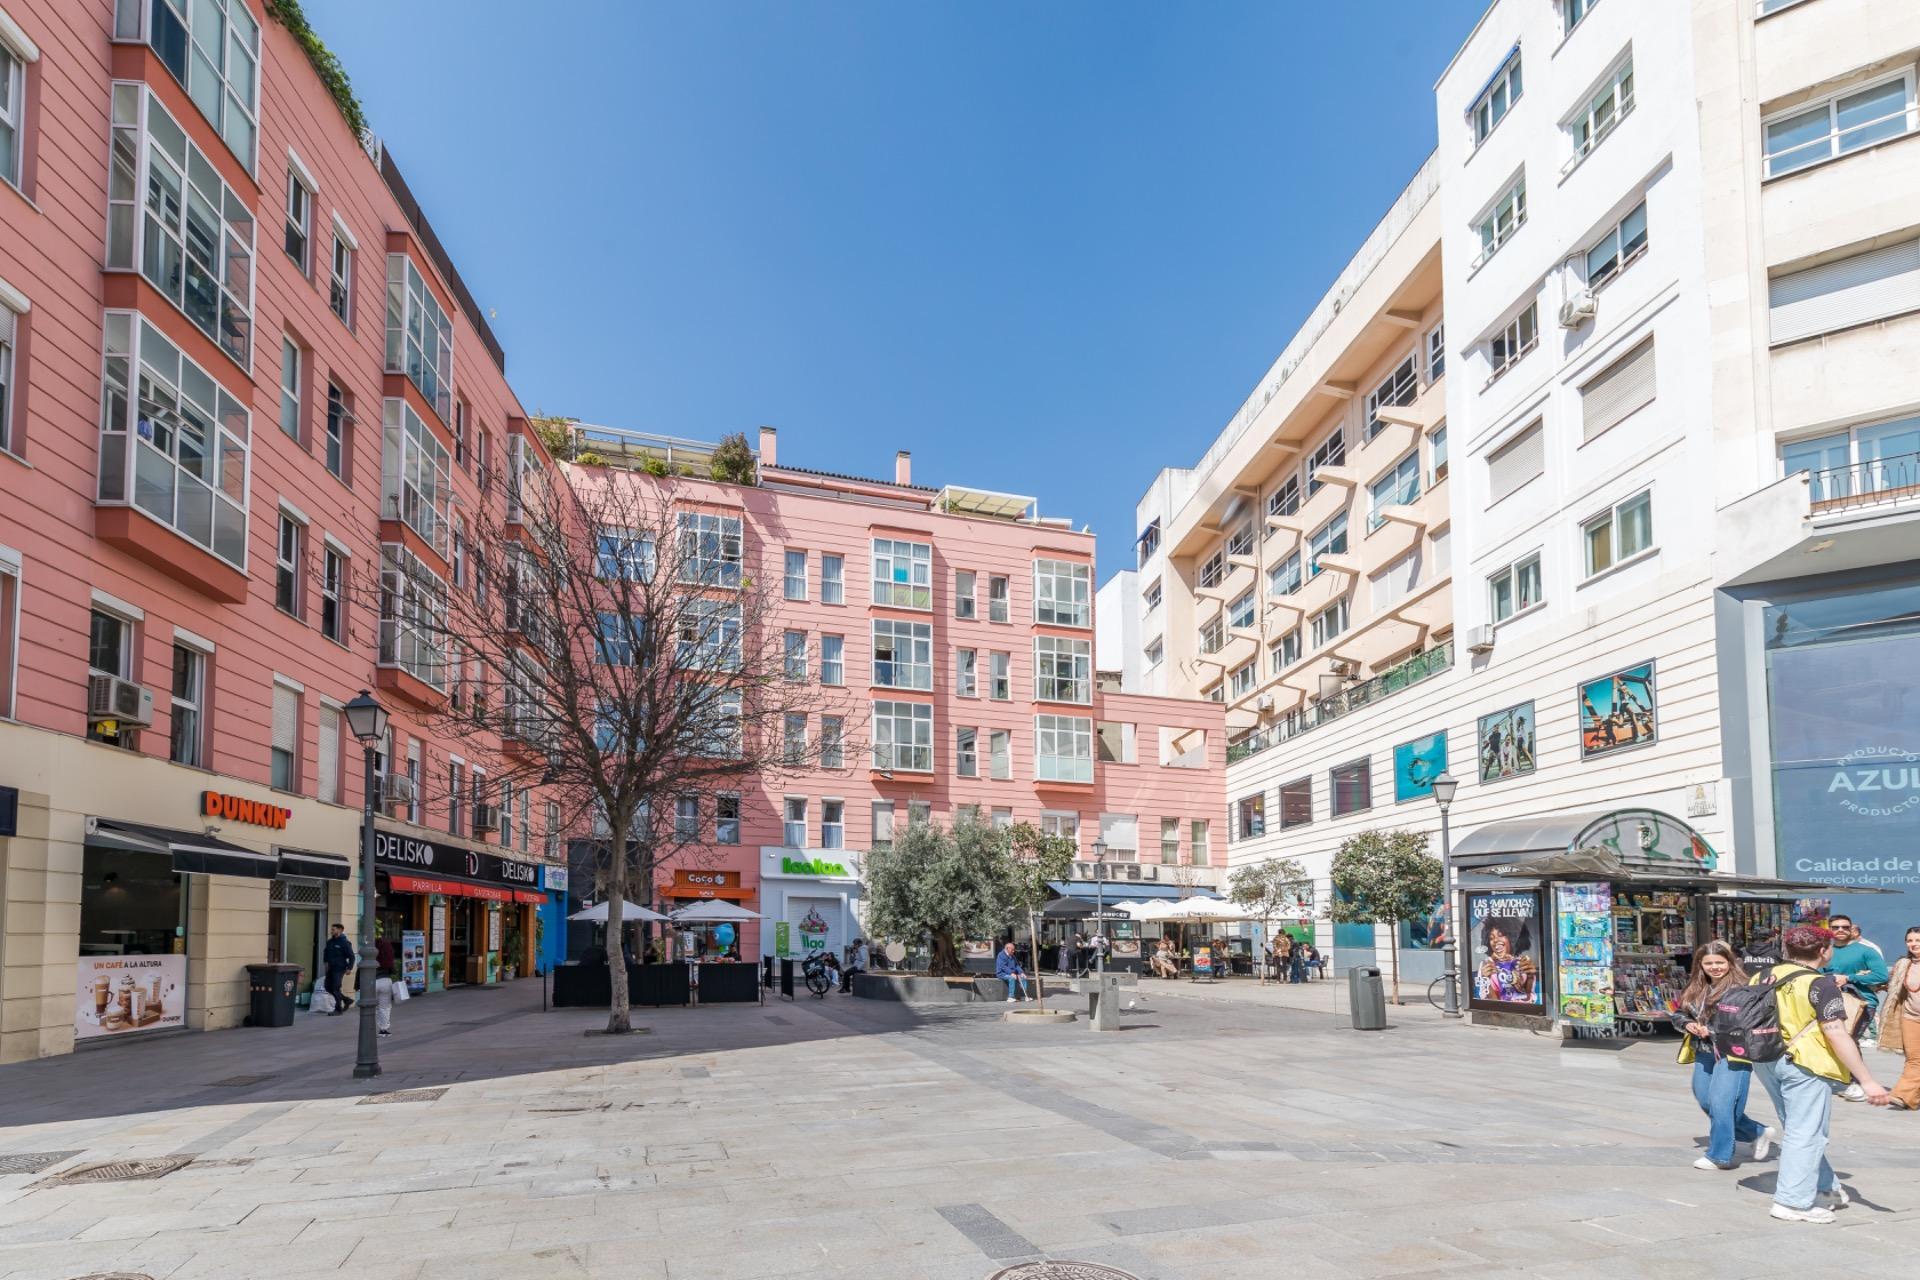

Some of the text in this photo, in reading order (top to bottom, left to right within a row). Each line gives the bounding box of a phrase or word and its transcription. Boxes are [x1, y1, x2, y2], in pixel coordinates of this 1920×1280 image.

[1795, 856, 1913, 872] Calidad de
[1809, 873, 1856, 885] precio
[1860, 873, 1878, 884] de
[1473, 899, 1488, 908] LAS
[1491, 908, 1501, 918] SE
[1744, 956, 1775, 964] Madrid
